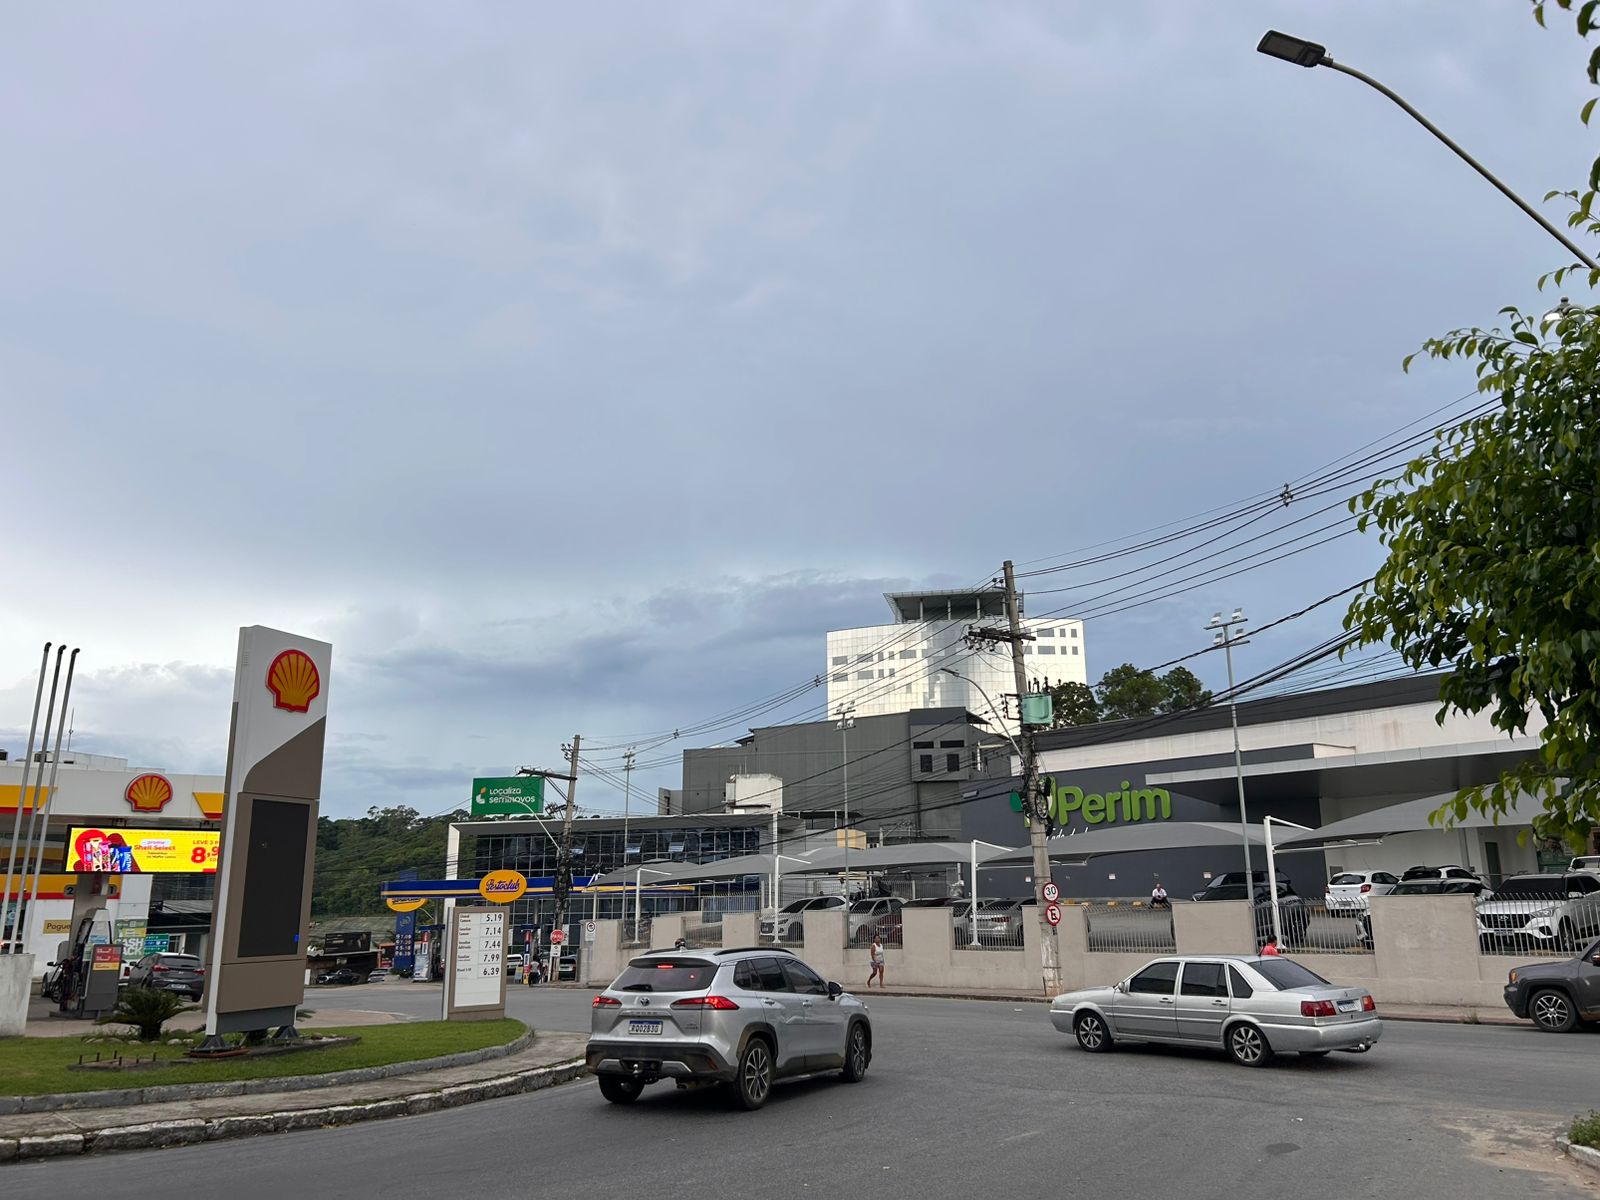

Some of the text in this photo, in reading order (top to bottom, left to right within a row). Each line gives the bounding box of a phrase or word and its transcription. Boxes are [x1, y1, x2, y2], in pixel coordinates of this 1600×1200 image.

[489, 786, 522, 796] Localiza
[488, 795, 536, 804] seminovos
[1057, 780, 1171, 826] Perim
[66, 886, 73, 895] 2
[1045, 886, 1056, 896] 30
[486, 913, 503, 922] 5.19
[1050, 908, 1056, 920] E
[485, 927, 502, 936] 7.14
[484, 940, 501, 949] 7.44
[483, 953, 500, 962] 7.99
[482, 967, 500, 976] 6.39
